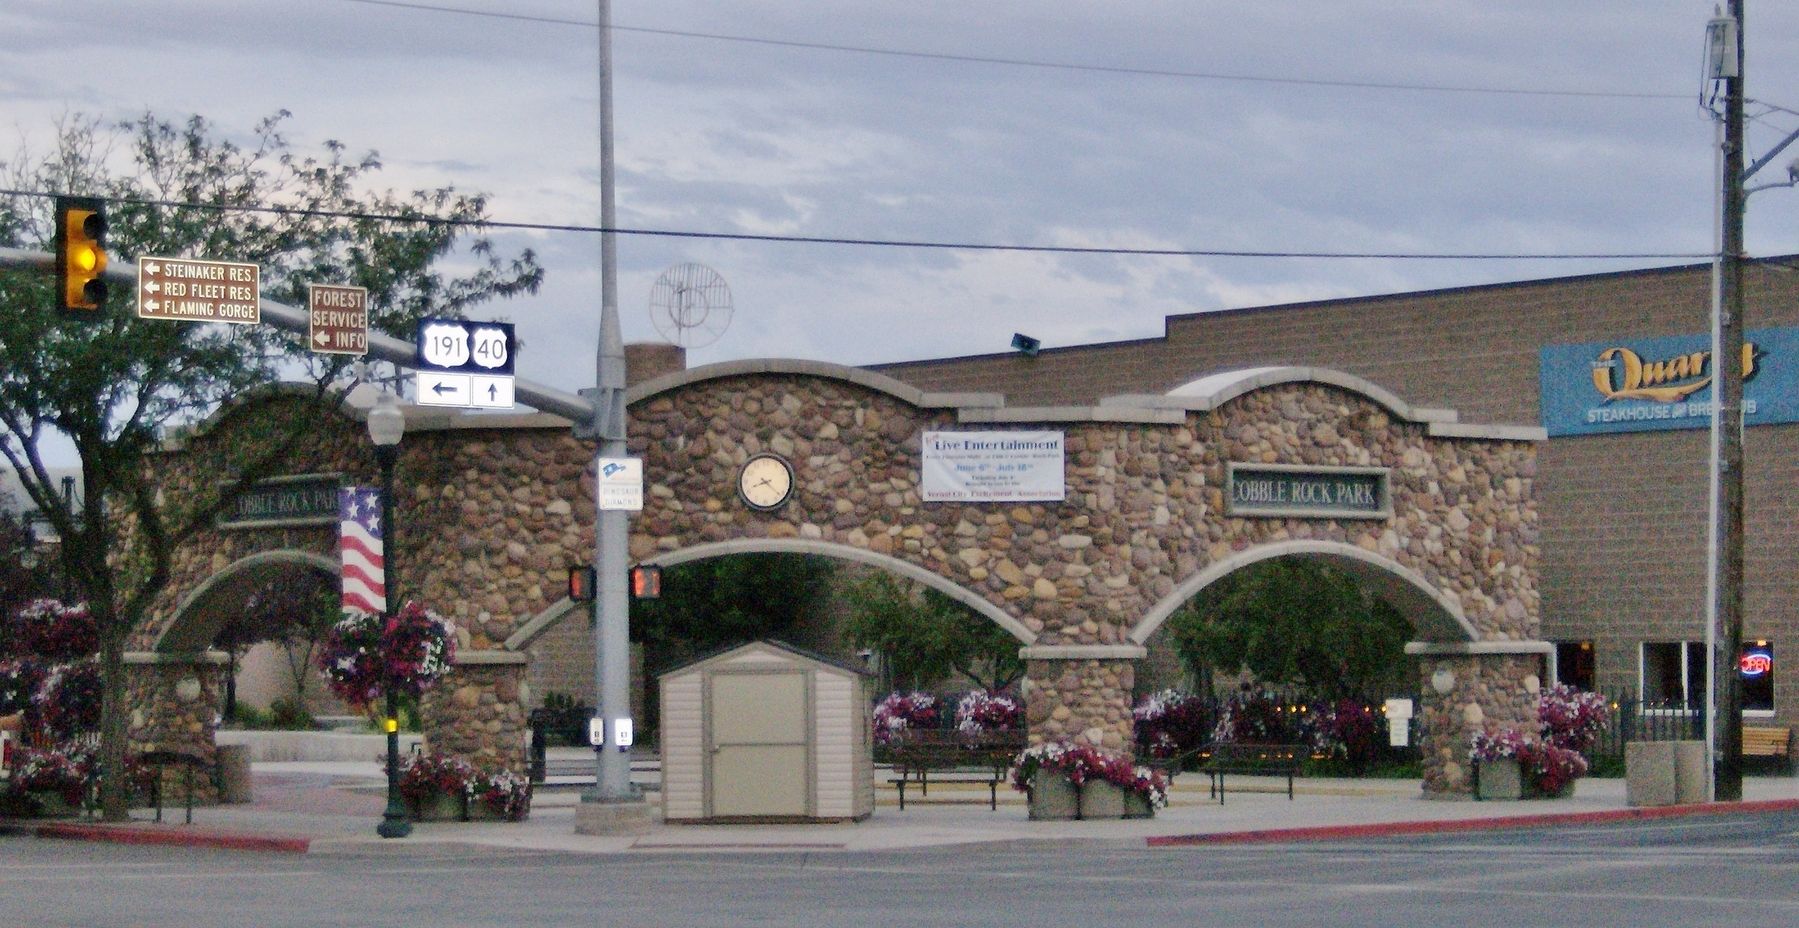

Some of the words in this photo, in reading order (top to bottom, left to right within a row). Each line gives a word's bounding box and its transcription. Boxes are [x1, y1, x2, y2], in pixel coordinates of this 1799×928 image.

[164, 263, 225, 281] STEINAKER
[229, 267, 255, 283] RES.
[164, 282, 187, 298] RED
[191, 284, 226, 300] FLEET
[229, 286, 255, 301] RES.
[314, 290, 363, 309] FOREST
[164, 300, 214, 317] FLAMING
[219, 303, 256, 319] GORGE
[312, 310, 366, 329] SERVICE
[336, 332, 365, 349] INFO
[433, 335, 461, 358] 191
[477, 338, 504, 360] 40
[1592, 342, 1757, 403] Quar
[1587, 405, 1670, 424] STEAKHOUSE
[935, 440, 961, 450] Live
[964, 440, 1059, 450] Entertainment
[1292, 481, 1331, 503] ROCK
[1336, 482, 1376, 504] PARK
[1741, 657, 1771, 672] OPEN
